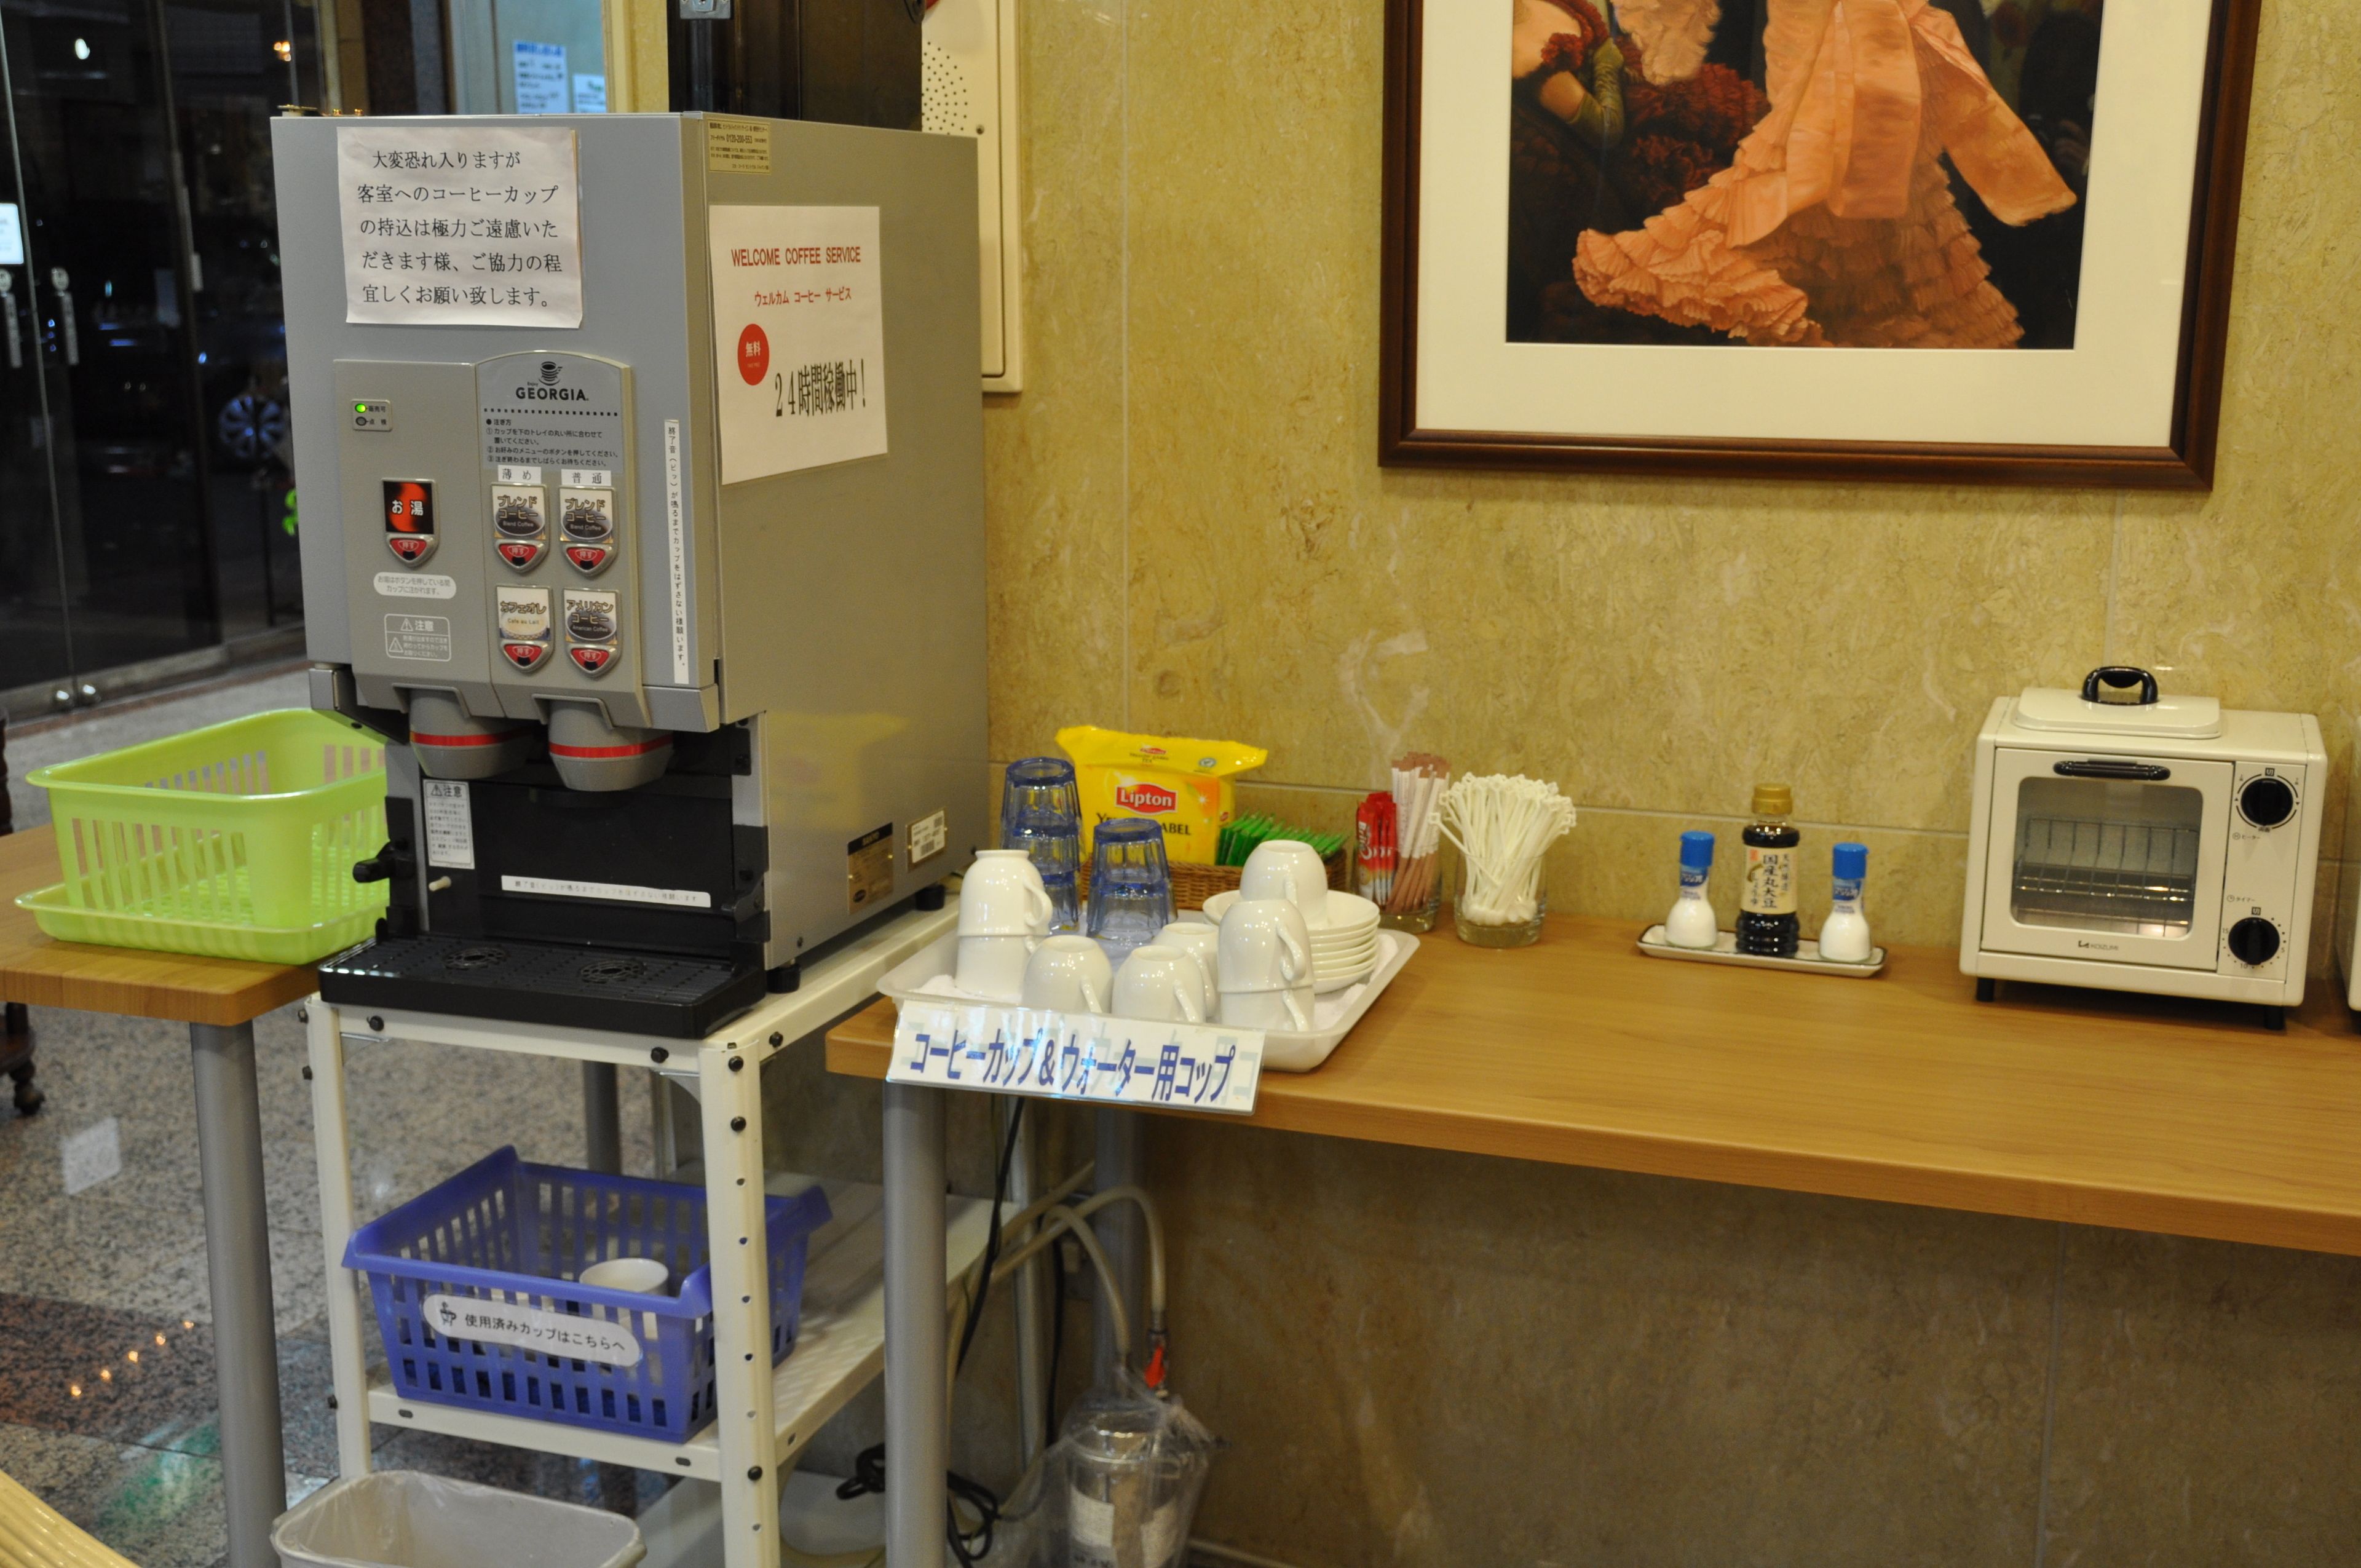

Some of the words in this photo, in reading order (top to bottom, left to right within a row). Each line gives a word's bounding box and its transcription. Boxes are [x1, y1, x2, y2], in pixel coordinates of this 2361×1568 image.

[373, 151, 521, 169] 大変恐れ入りますが
[357, 184, 559, 204] 客室へのコーヒーカップ
[360, 218, 559, 239] の持込は極力ご遠慮いた
[362, 251, 563, 272] だきます様、ご協力の程
[731, 248, 781, 266] WELCOME
[785, 247, 821, 264] COFFEE
[826, 246, 861, 263] SERVICE
[362, 285, 548, 307] 宜しくお願い致します。
[754, 291, 789, 307] ウェルカム
[794, 290, 821, 303] コーヒー
[826, 286, 852, 302] サービス
[745, 341, 761, 357] 無料
[515, 387, 587, 401] GEORGIA
[392, 499, 424, 516] お湯
[497, 495, 537, 508] ブレンド
[565, 497, 606, 512] ブレンド
[499, 509, 539, 520] コーヒー
[566, 512, 606, 523] コーヒー
[500, 600, 547, 614] カフェオレ
[566, 600, 614, 613] アメリカン
[572, 613, 609, 624] コーヒー
[1120, 788, 1173, 808] Lipton
[1161, 822, 1192, 836] ABEL
[1762, 853, 1779, 908] 国産丸大豆
[910, 1027, 1236, 1104] コーヒーカップ&ウォーター用コップ
[465, 1313, 625, 1352] 使用済みカップはこちらへ
